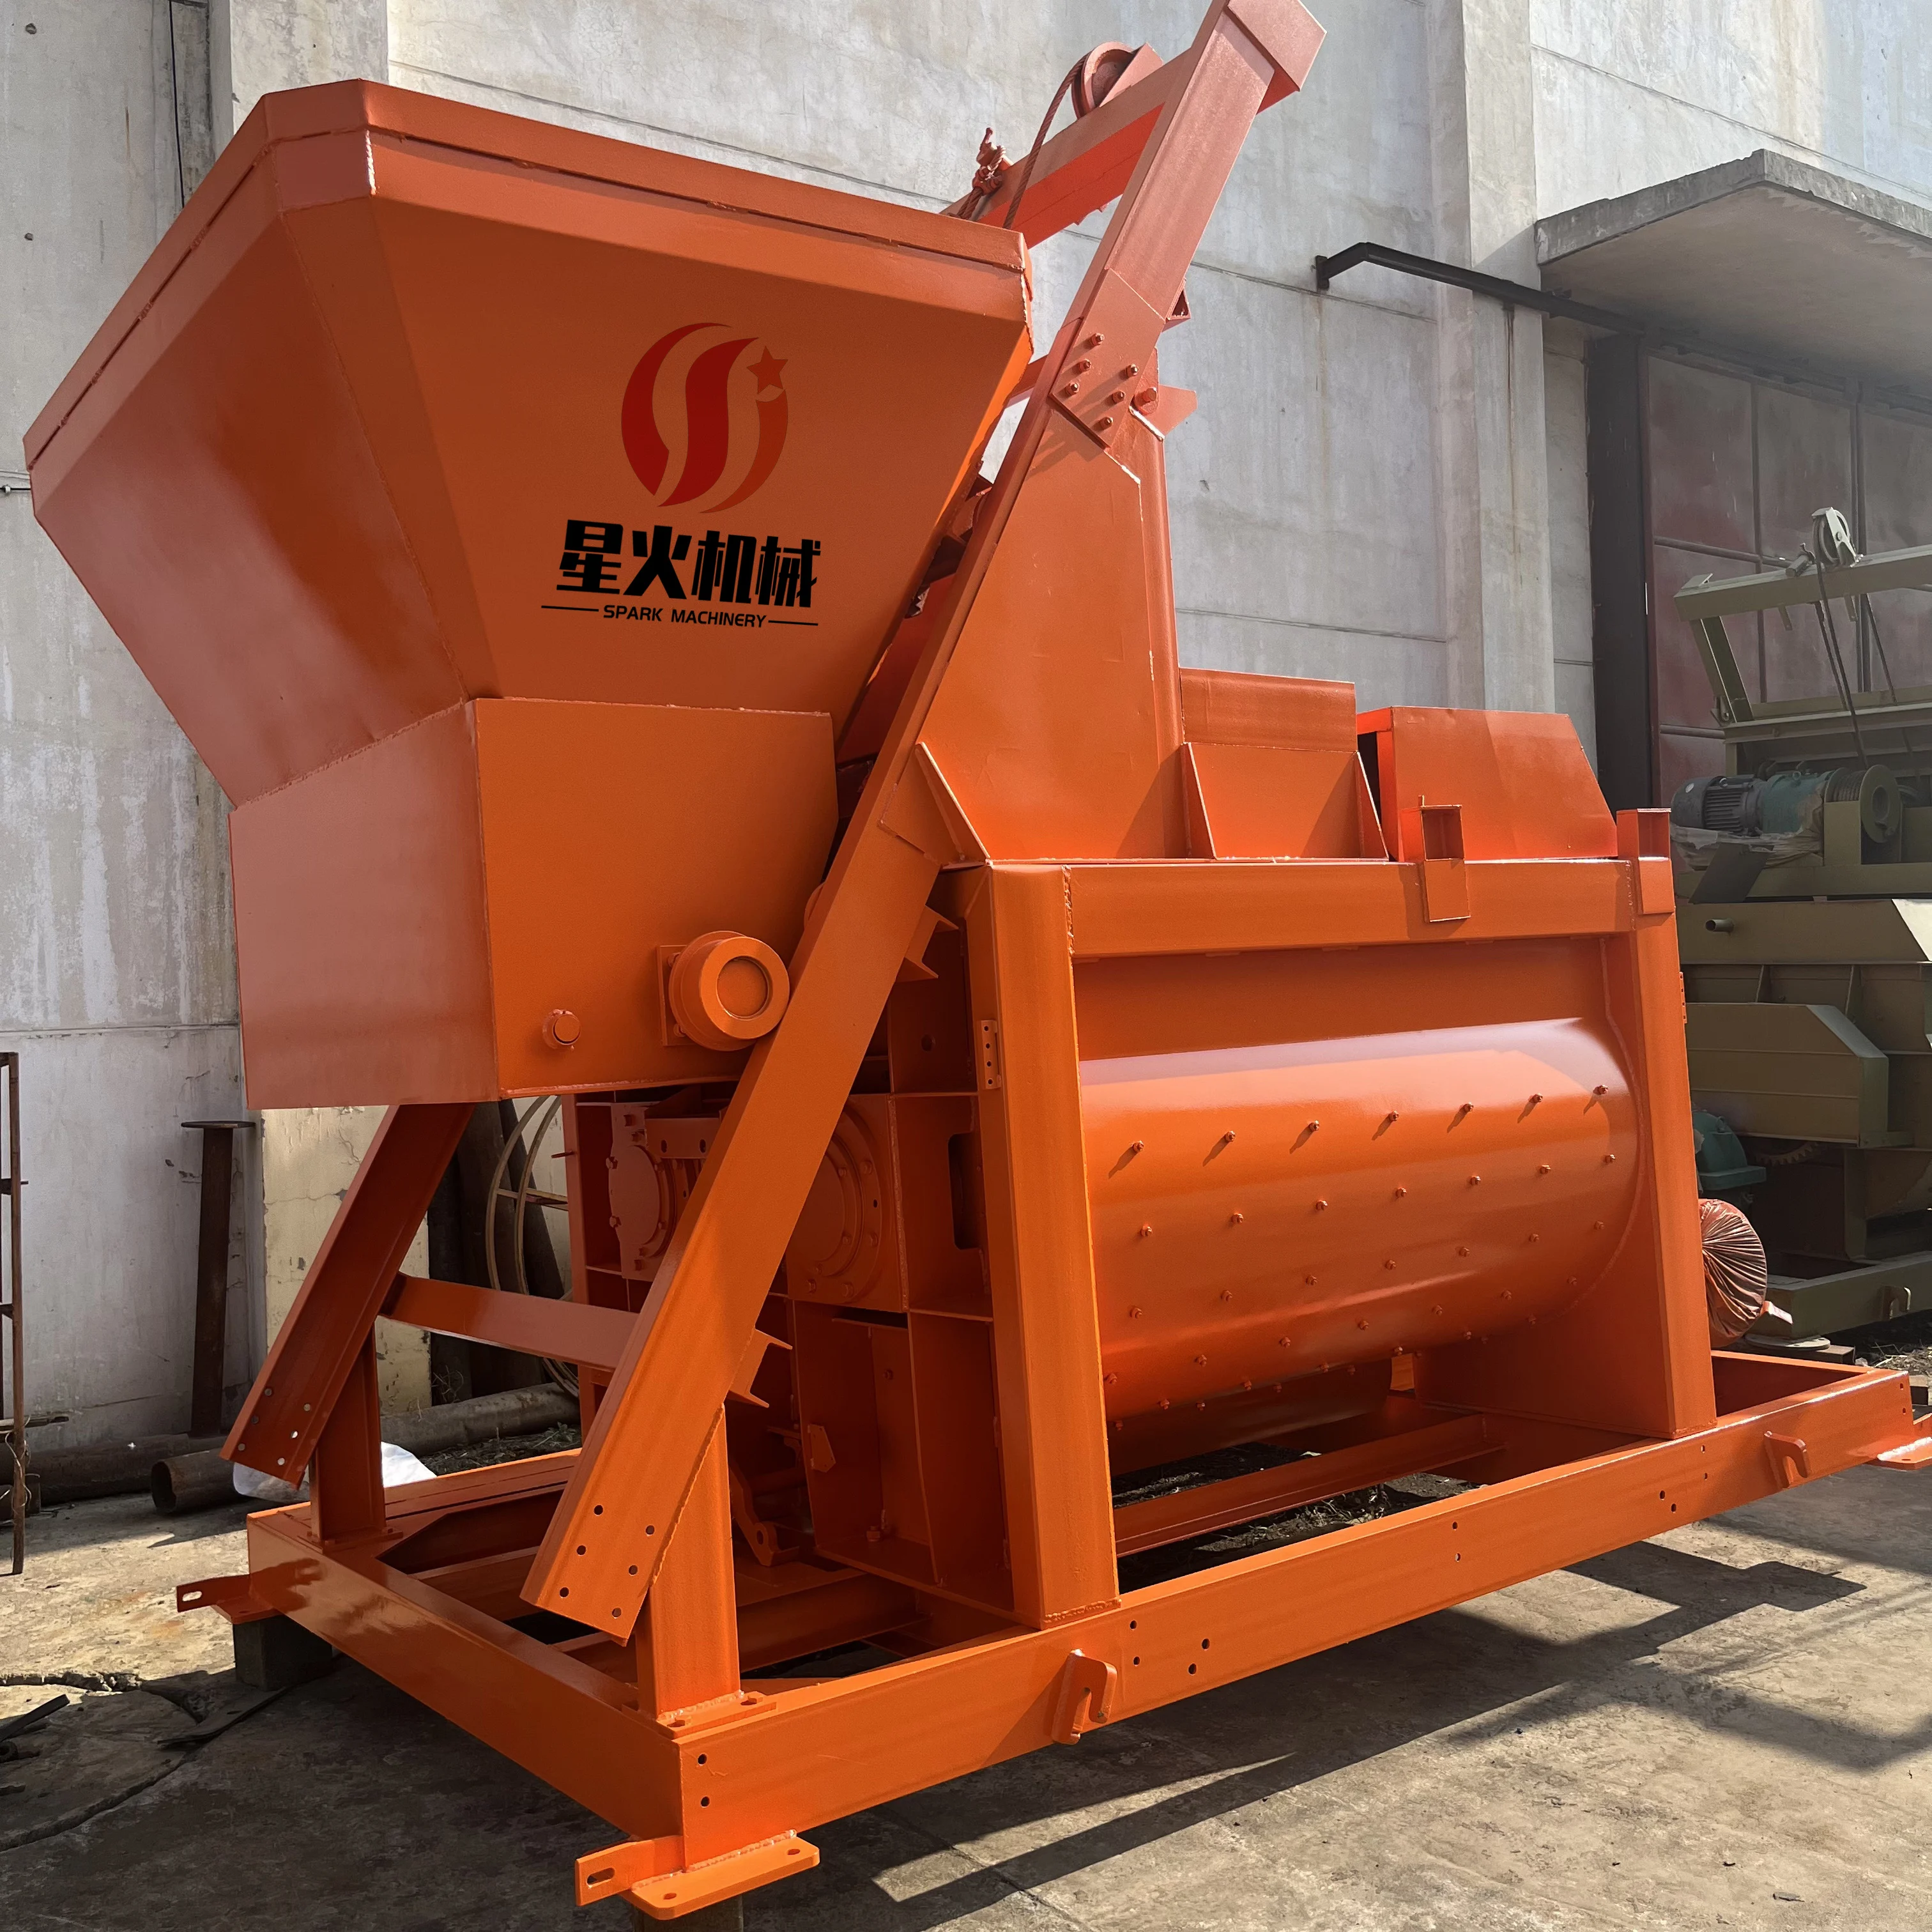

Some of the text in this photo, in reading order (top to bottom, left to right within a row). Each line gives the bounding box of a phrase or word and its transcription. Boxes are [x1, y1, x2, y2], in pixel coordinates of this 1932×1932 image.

[555, 518, 822, 609] 星火机械
[602, 604, 767, 629] SPARK MACHINERY
